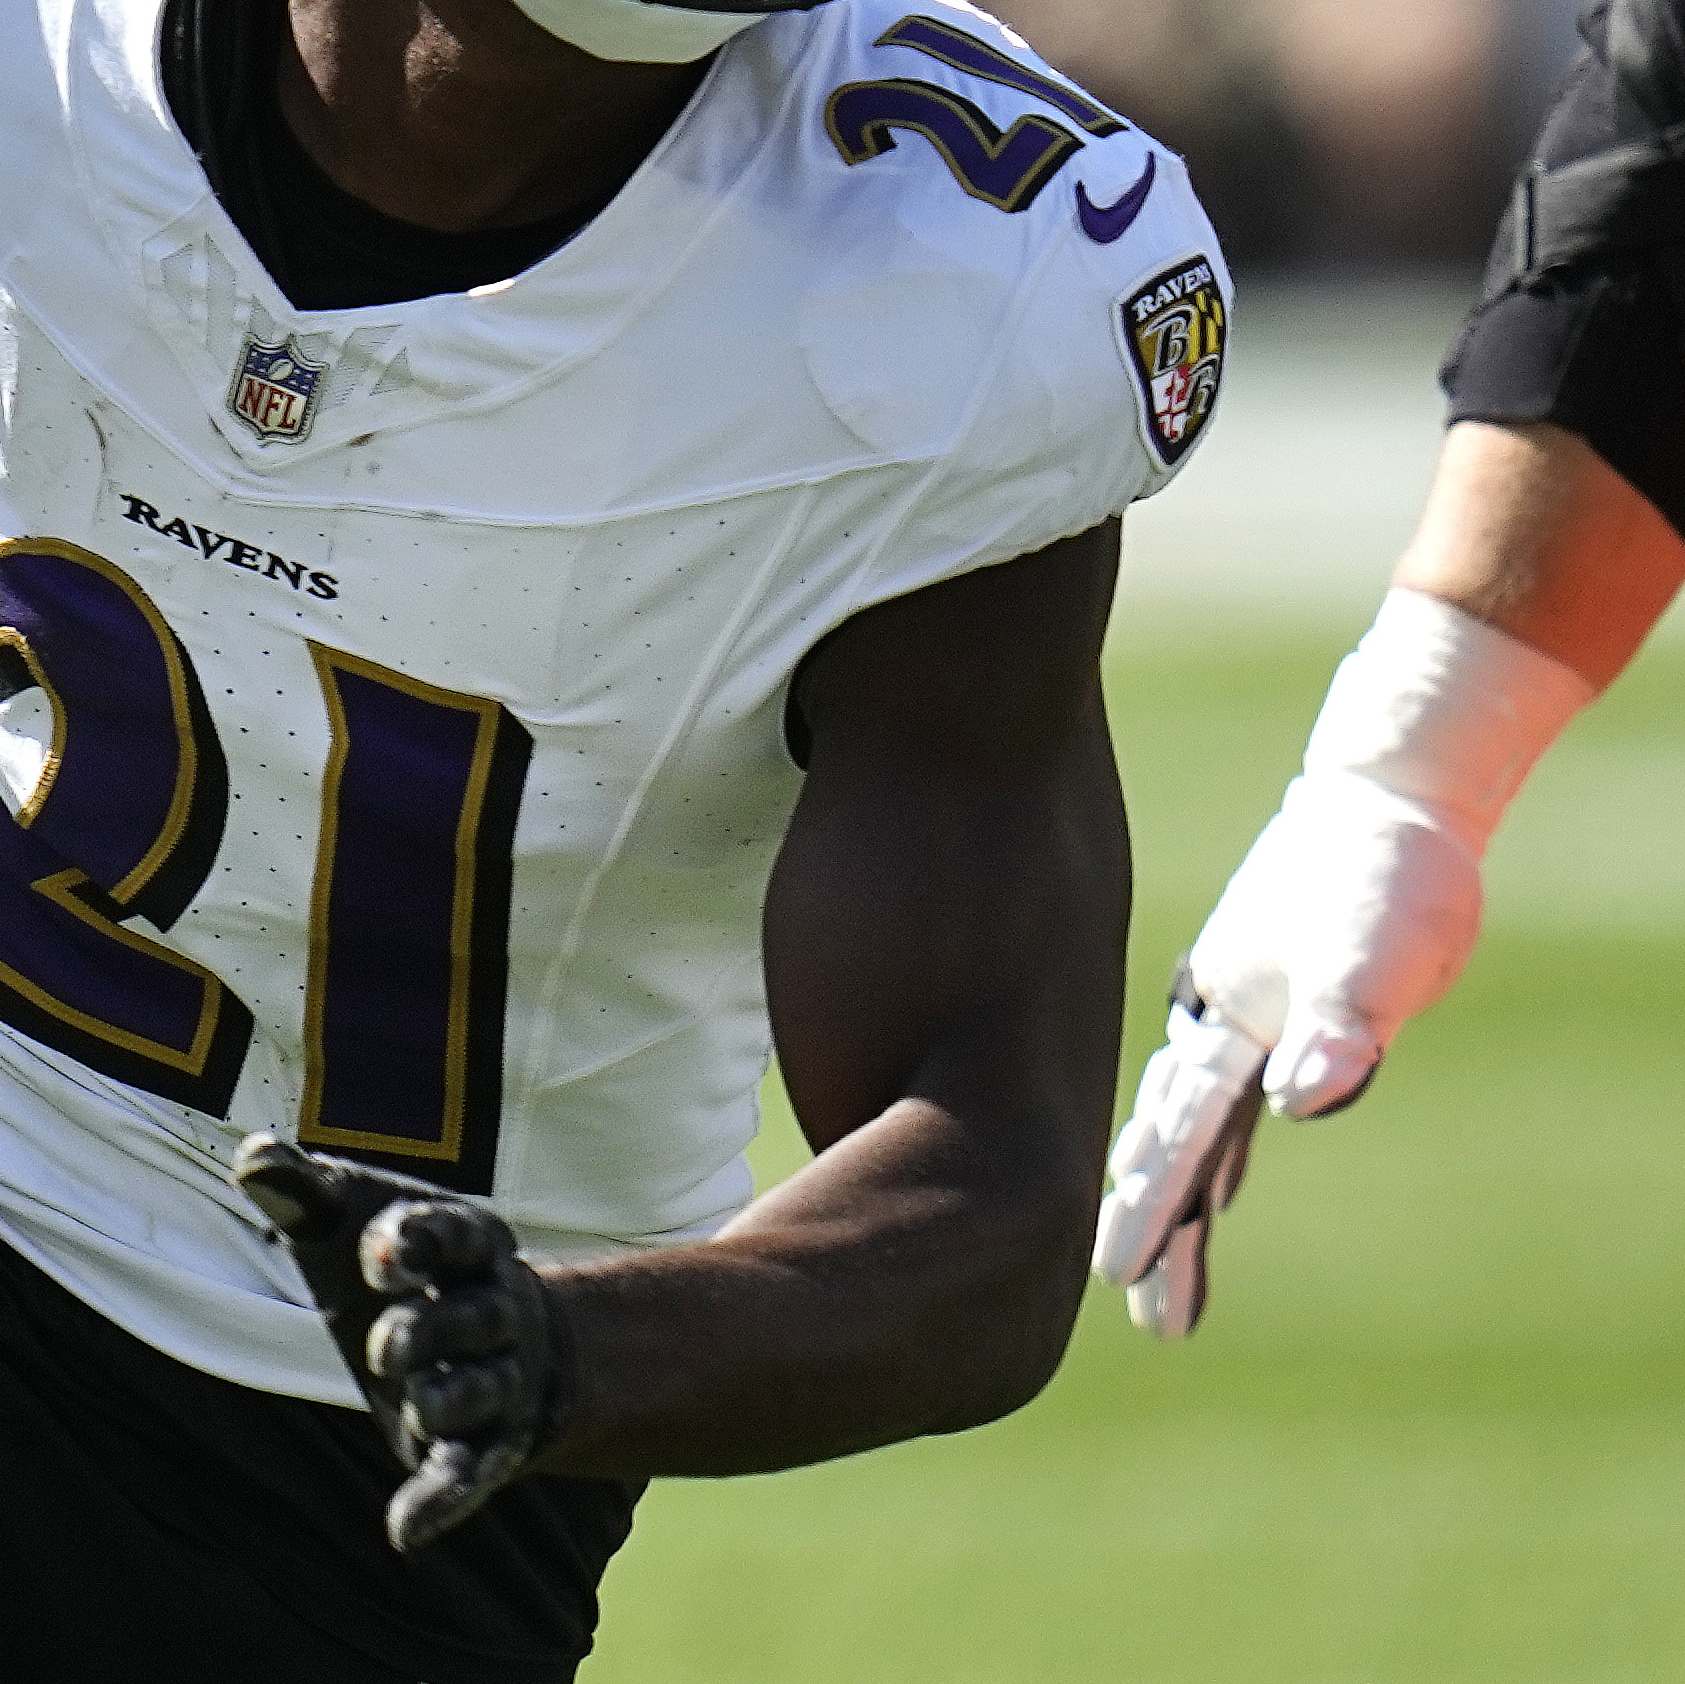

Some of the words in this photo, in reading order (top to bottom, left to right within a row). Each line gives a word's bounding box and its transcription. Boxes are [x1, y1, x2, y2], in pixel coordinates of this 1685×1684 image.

[825, 14, 1130, 214] 21
[239, 376, 298, 429] NFL
[119, 494, 339, 599] RAVENS
